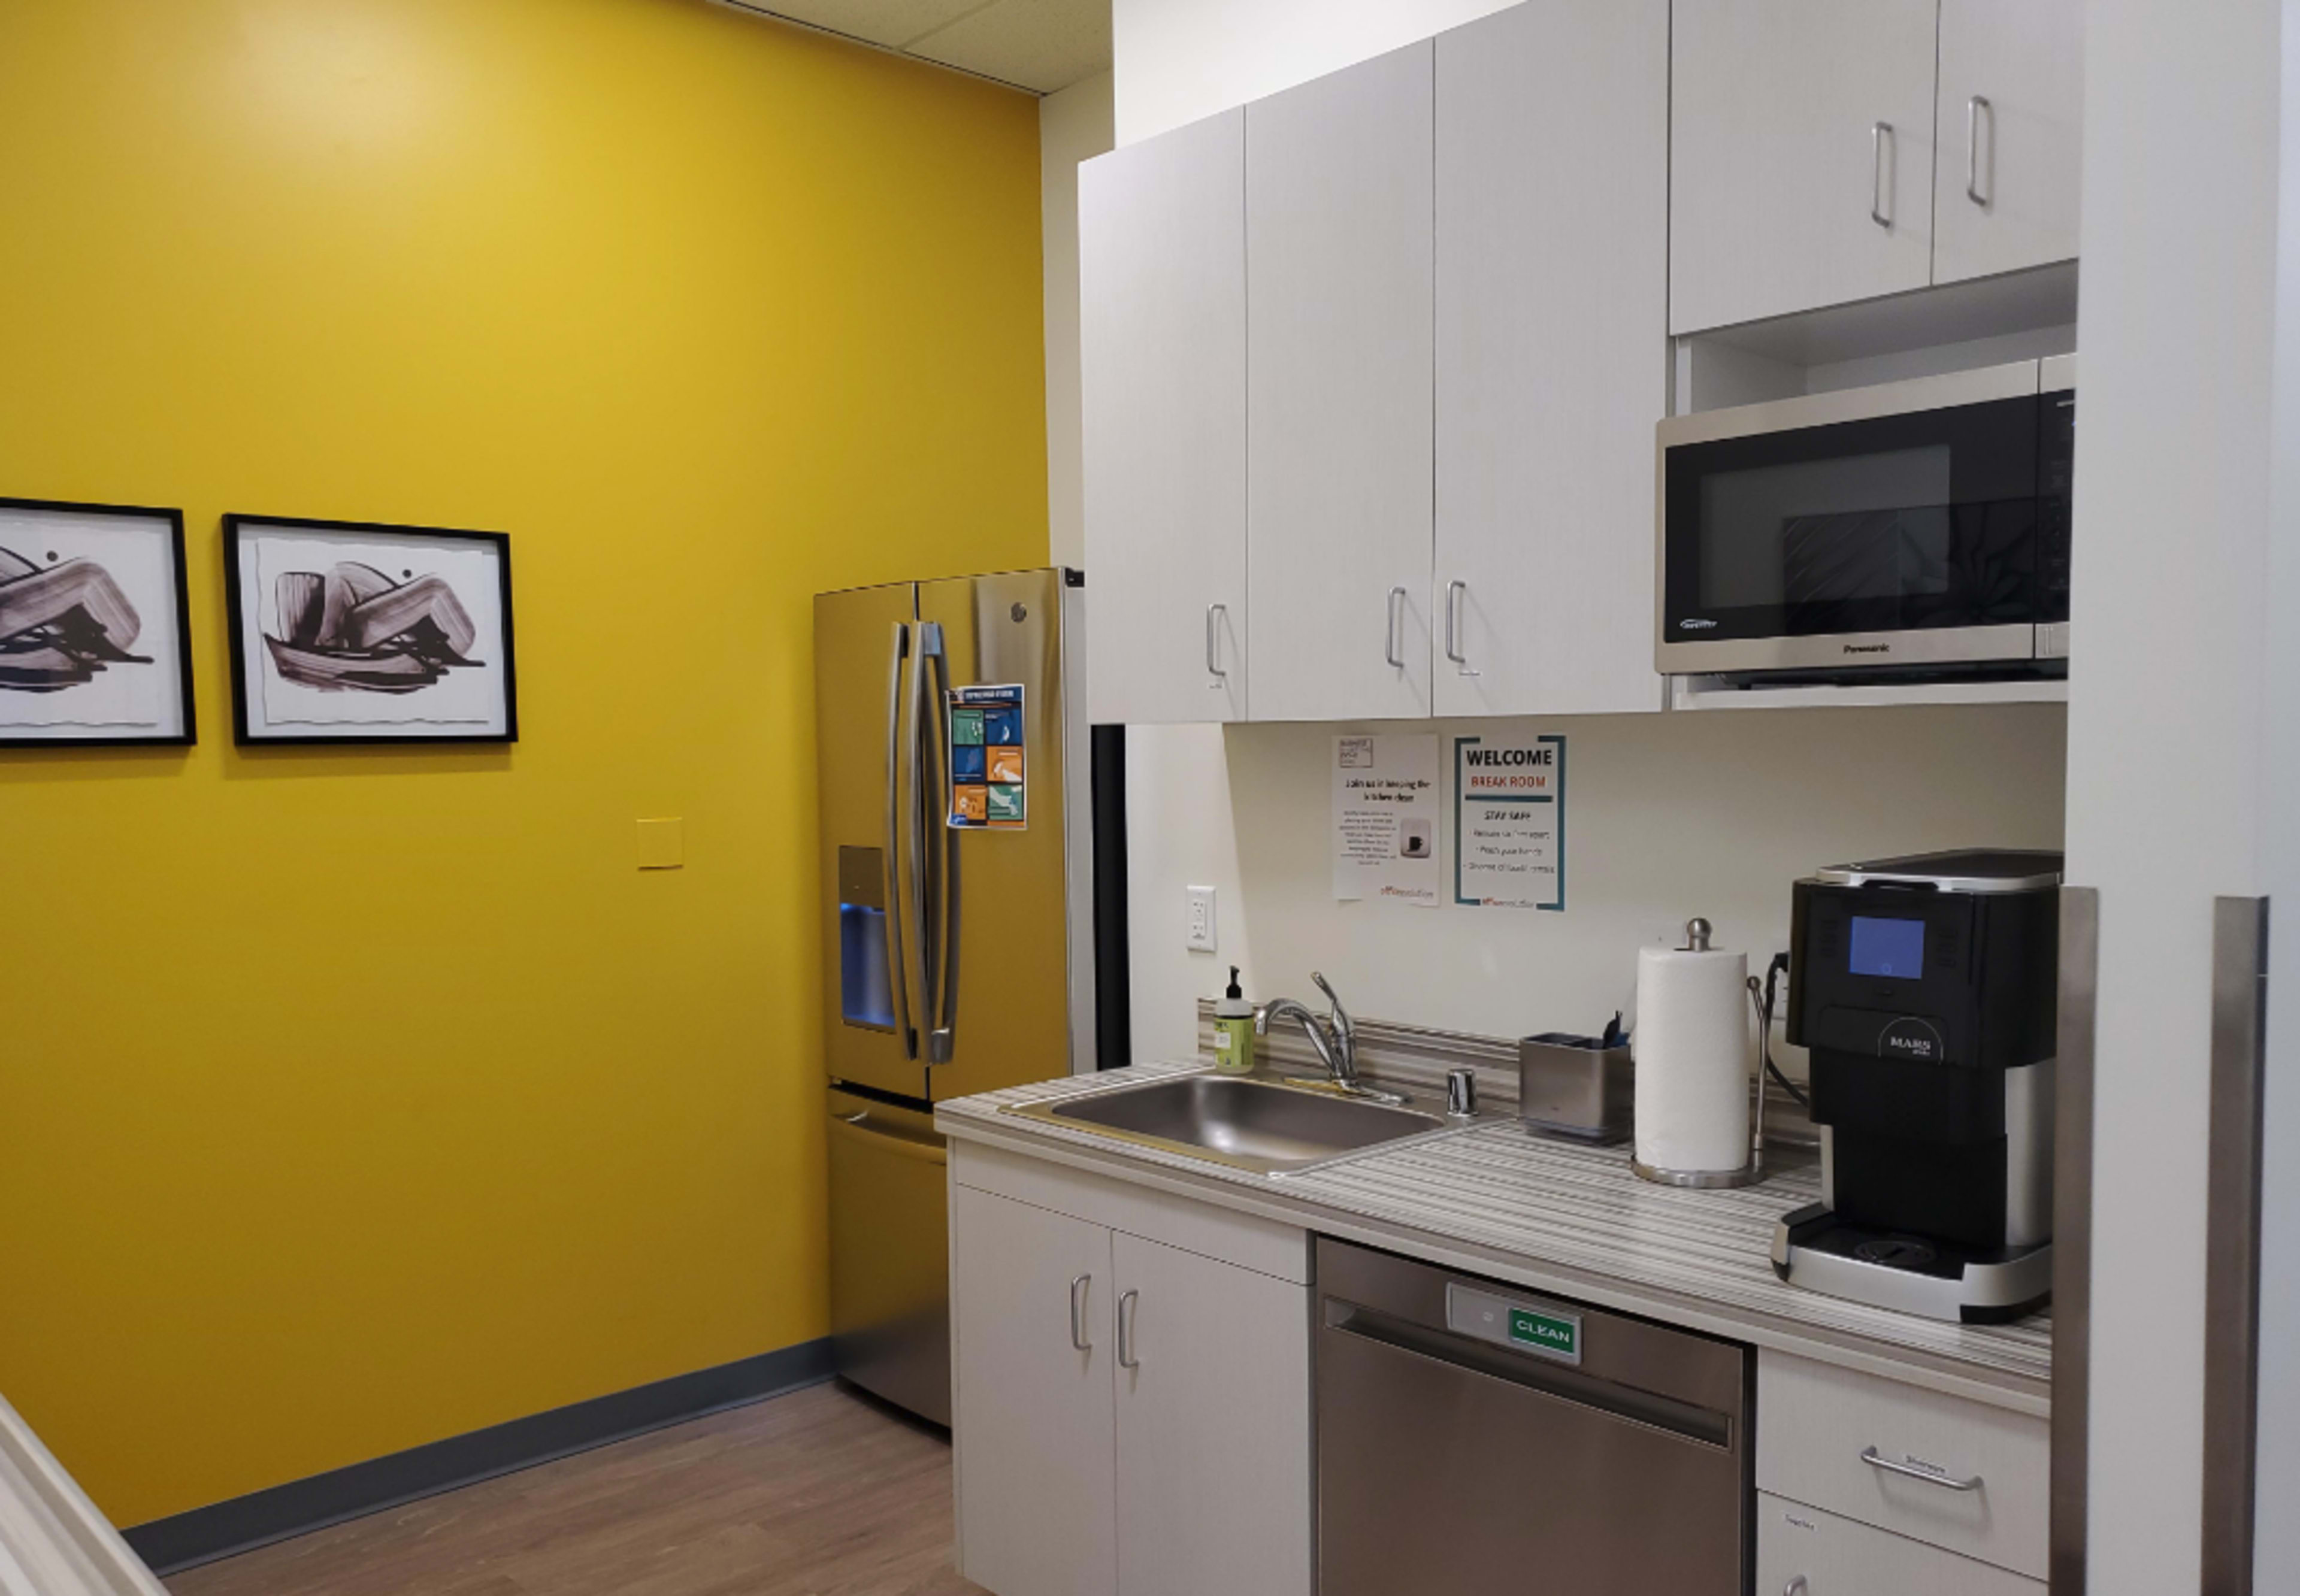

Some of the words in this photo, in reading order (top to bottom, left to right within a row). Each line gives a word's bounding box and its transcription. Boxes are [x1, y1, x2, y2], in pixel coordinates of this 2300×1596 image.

[1844, 643, 1889, 654] Panasonic
[1466, 750, 1552, 766] WELCOME
[1471, 776, 1506, 788] BREAK
[1510, 776, 1545, 788] ROOM
[1484, 811, 1506, 820] STAY
[1891, 1037, 1930, 1050] MARS
[1517, 1320, 1569, 1343] CLEAN
